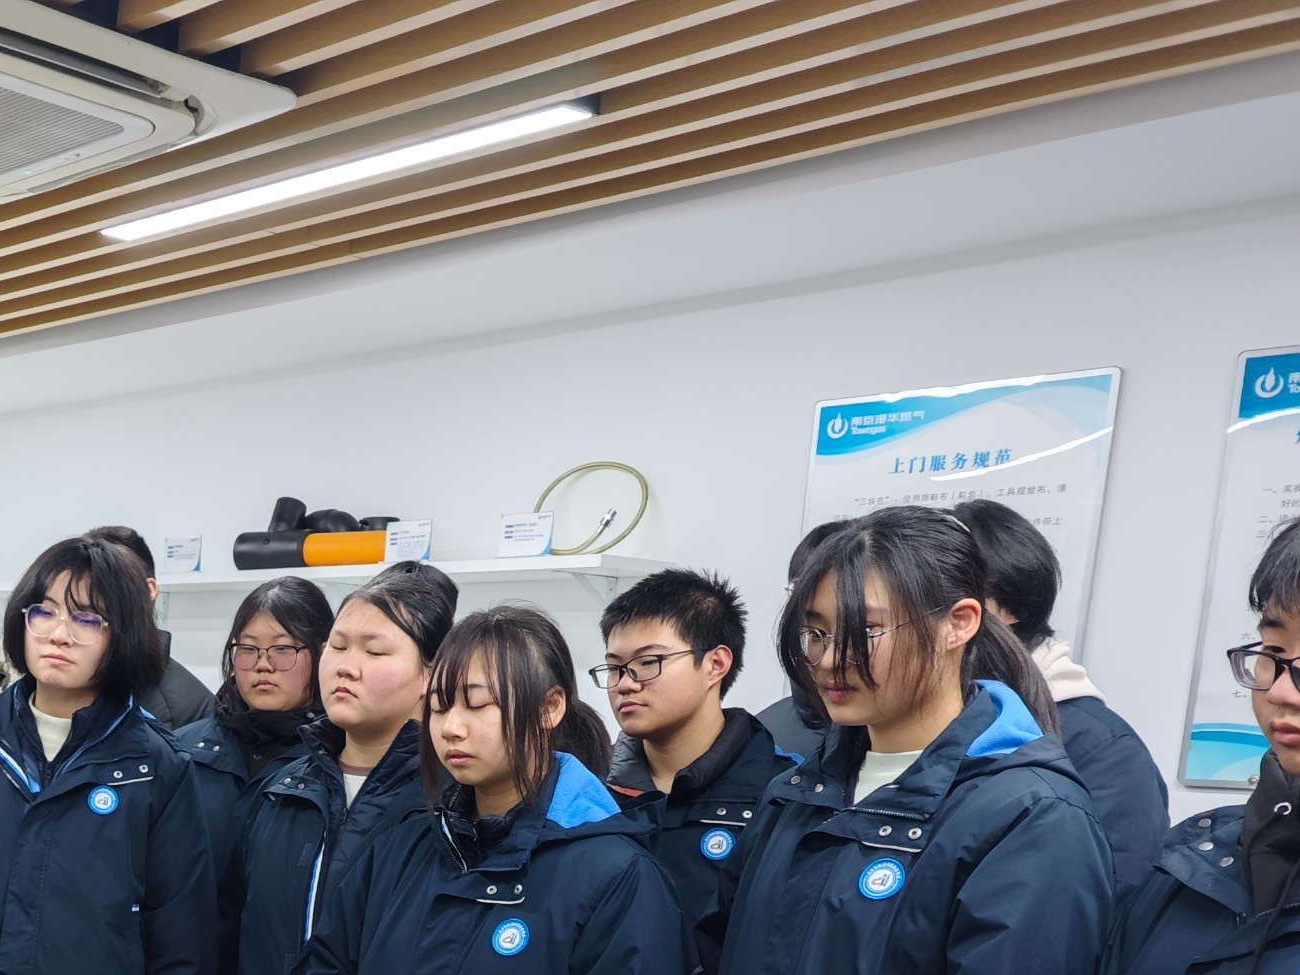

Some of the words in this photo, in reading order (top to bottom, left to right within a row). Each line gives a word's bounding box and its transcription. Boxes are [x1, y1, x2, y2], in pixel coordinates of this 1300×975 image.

[851, 410, 925, 427] 南京港华燃气
[851, 425, 887, 436] Towngas
[887, 448, 1013, 474] 上门服务规范
